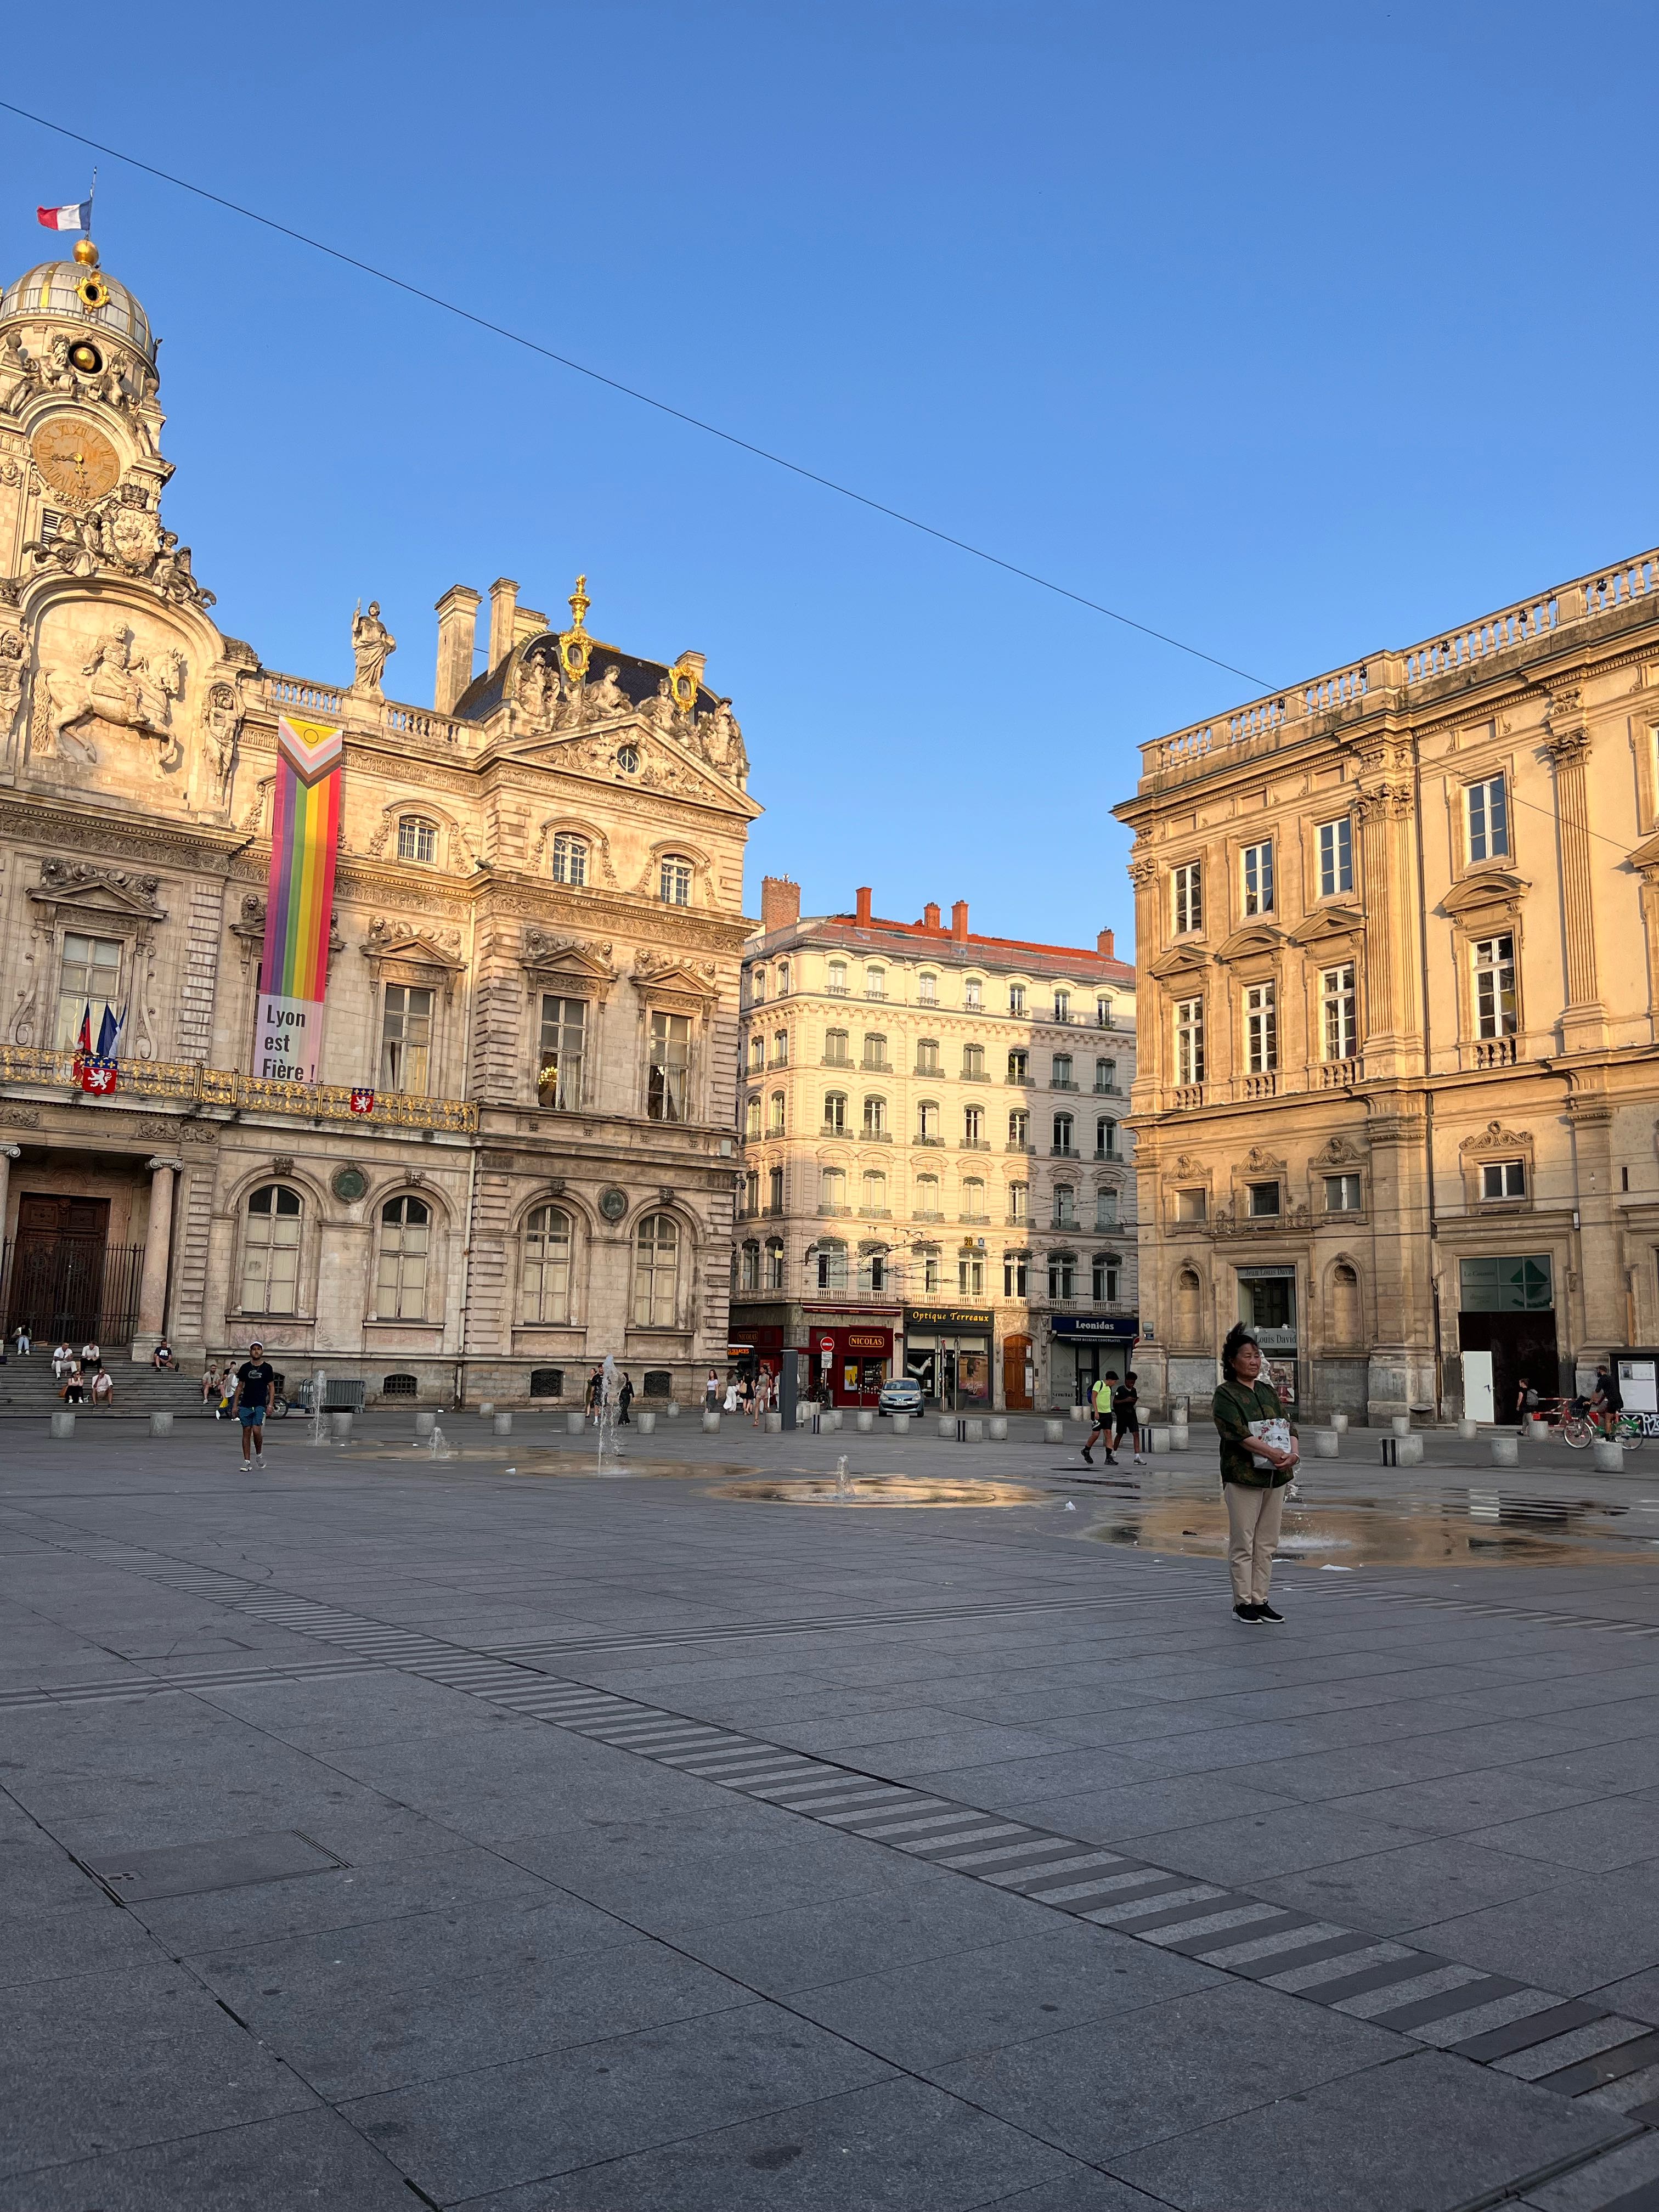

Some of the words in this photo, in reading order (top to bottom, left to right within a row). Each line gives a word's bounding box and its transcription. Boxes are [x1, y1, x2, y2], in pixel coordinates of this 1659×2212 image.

[267, 1005, 306, 1028] Lyon
[264, 1035, 290, 1052] est
[262, 1058, 304, 1081] Fière
[310, 1064, 315, 1082] !
[912, 1311, 946, 1323] Optique
[950, 1311, 989, 1322] Terreaux
[1076, 1320, 1114, 1330] Leonidas
[1255, 1334, 1274, 1344] Louis
[1276, 1334, 1296, 1344] David
